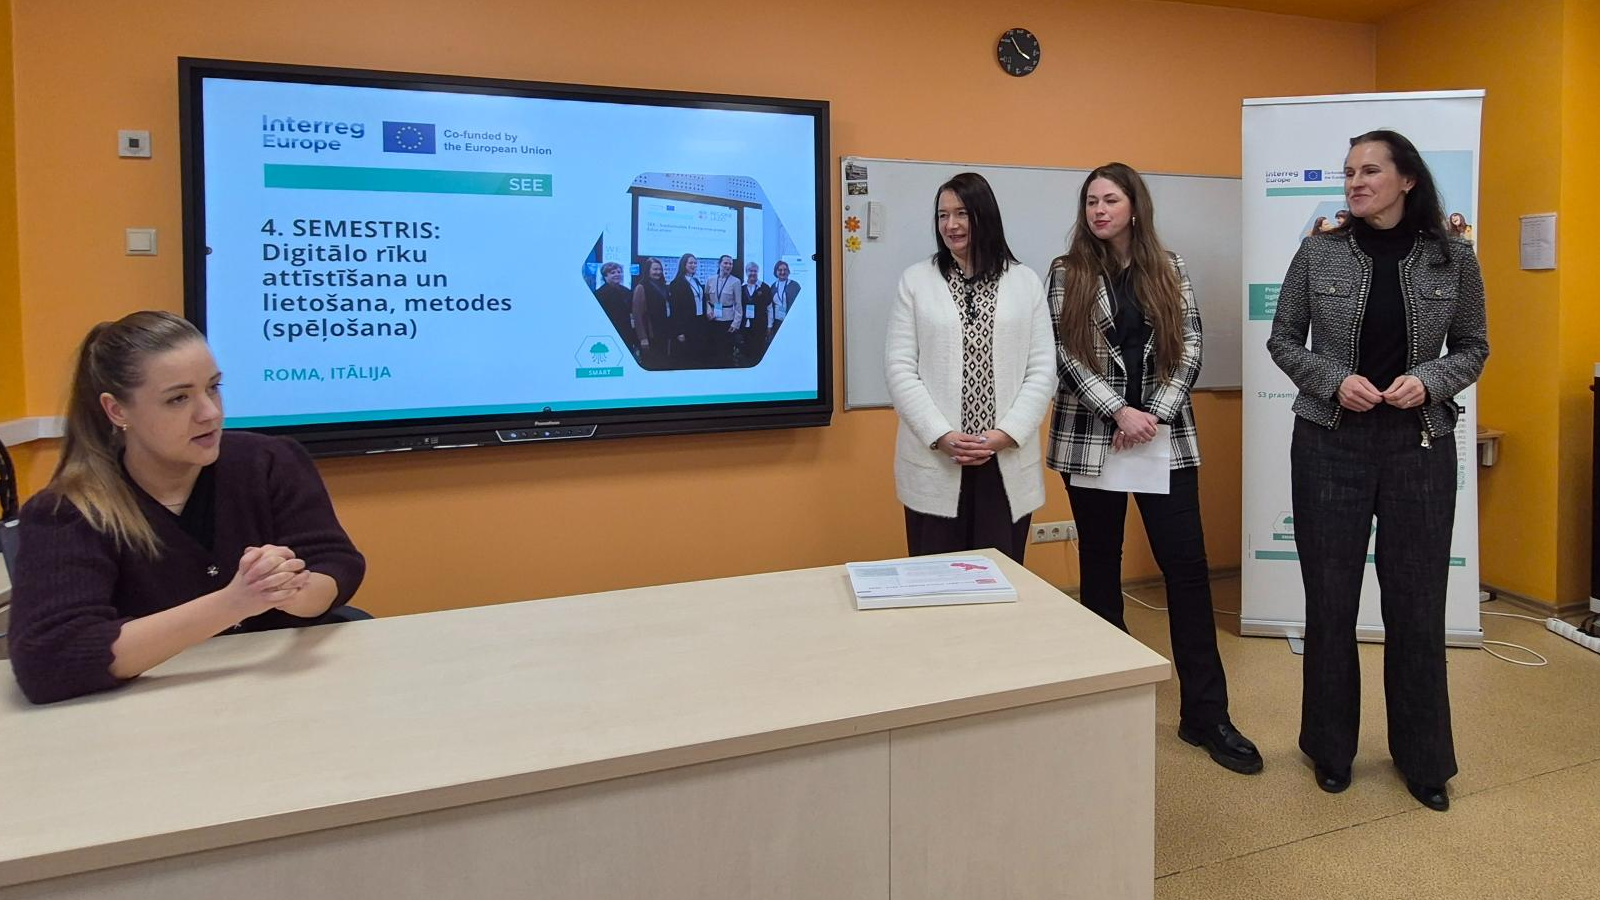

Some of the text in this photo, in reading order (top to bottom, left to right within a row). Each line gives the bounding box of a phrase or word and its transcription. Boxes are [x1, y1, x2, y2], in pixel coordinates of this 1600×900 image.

[262, 114, 365, 139] Interreg
[443, 128, 518, 143] Co-funded by
[262, 133, 342, 153] Europe
[443, 142, 552, 155] the European Union
[1265, 170, 1299, 178] Interreg
[508, 178, 544, 192] SEE
[260, 218, 441, 239] 4. SEMESTRIS:
[262, 243, 428, 267] Digitālo rīku
[262, 268, 448, 288] attīstīšana un
[262, 293, 512, 315] lietošana, metodes
[262, 317, 418, 343] (spēļošana)
[263, 365, 392, 383] ROMA, ITĀLIJA
[588, 368, 612, 376] SMART
